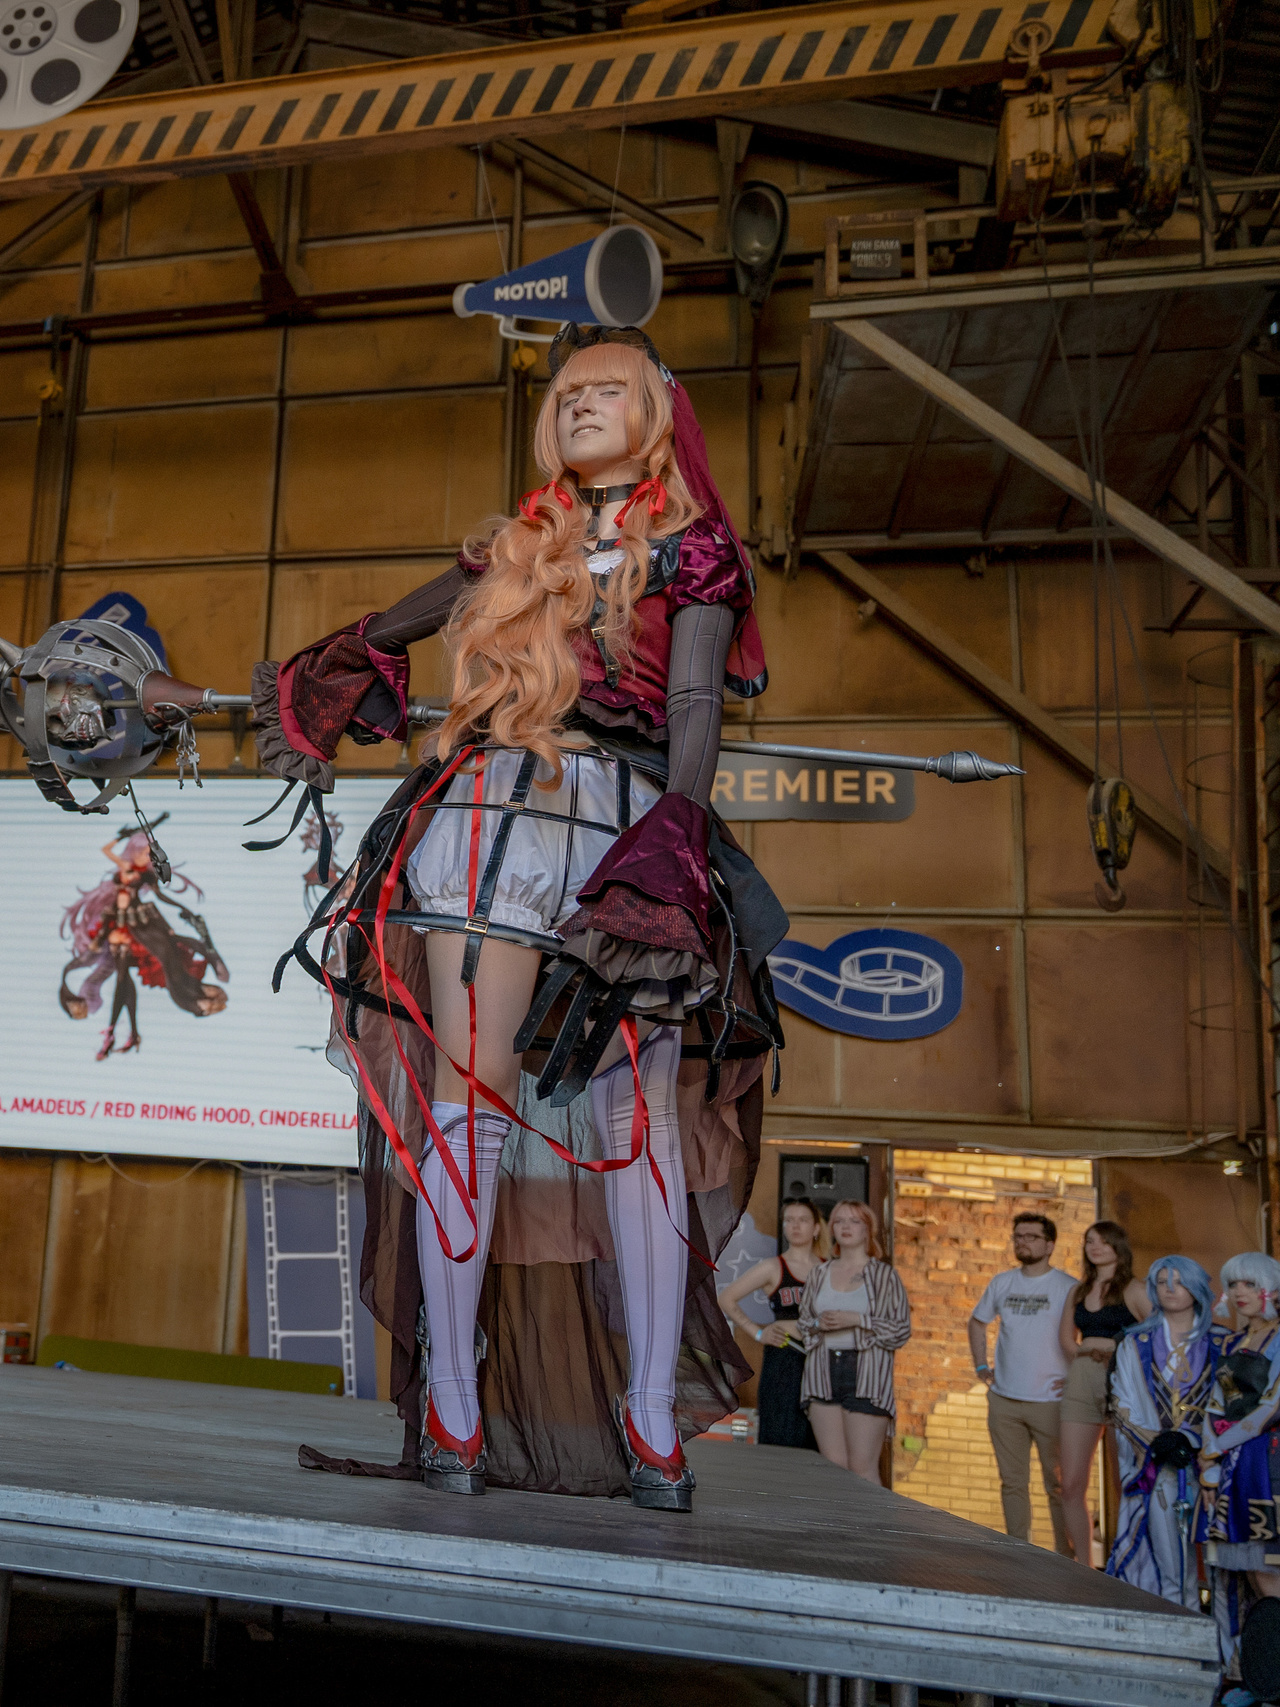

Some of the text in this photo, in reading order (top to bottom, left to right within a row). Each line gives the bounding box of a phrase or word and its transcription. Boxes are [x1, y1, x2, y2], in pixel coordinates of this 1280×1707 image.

[494, 275, 569, 301] МОТОР!
[710, 768, 896, 804] REMIER
[11, 1098, 86, 1116] AMADEUS
[90, 1102, 99, 1119] /
[103, 1102, 135, 1118] RED
[140, 1103, 197, 1121] RIDING
[202, 1107, 255, 1128] HOOD,
